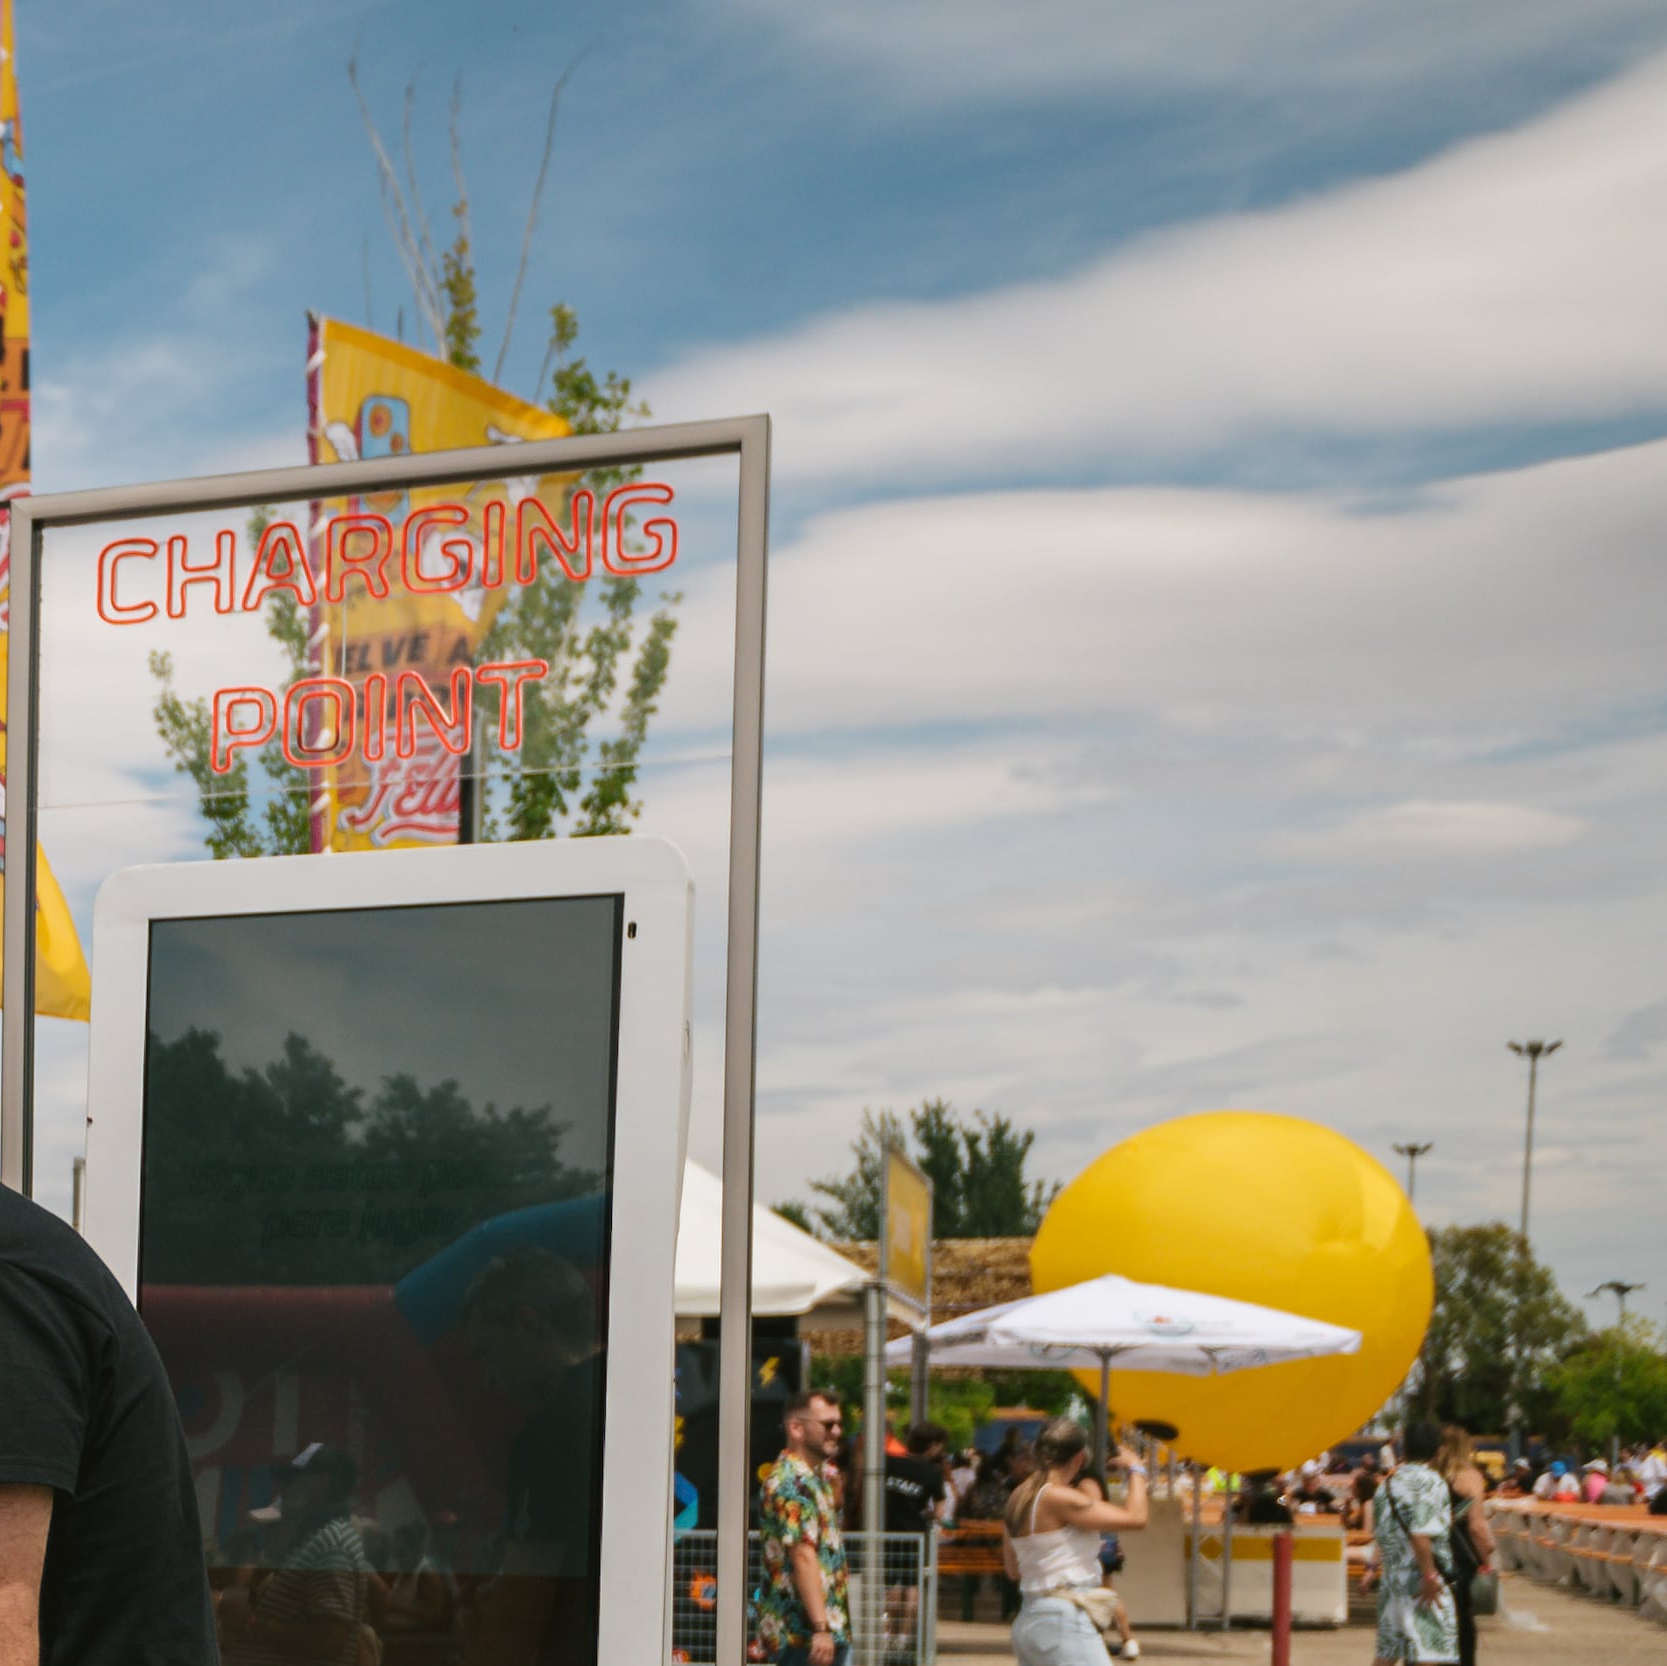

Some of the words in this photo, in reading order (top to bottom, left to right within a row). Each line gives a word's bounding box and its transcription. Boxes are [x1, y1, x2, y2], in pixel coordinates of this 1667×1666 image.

[97, 482, 679, 626] CHARGING
[335, 632, 430, 674] ELVE
[210, 659, 549, 774] POINT
